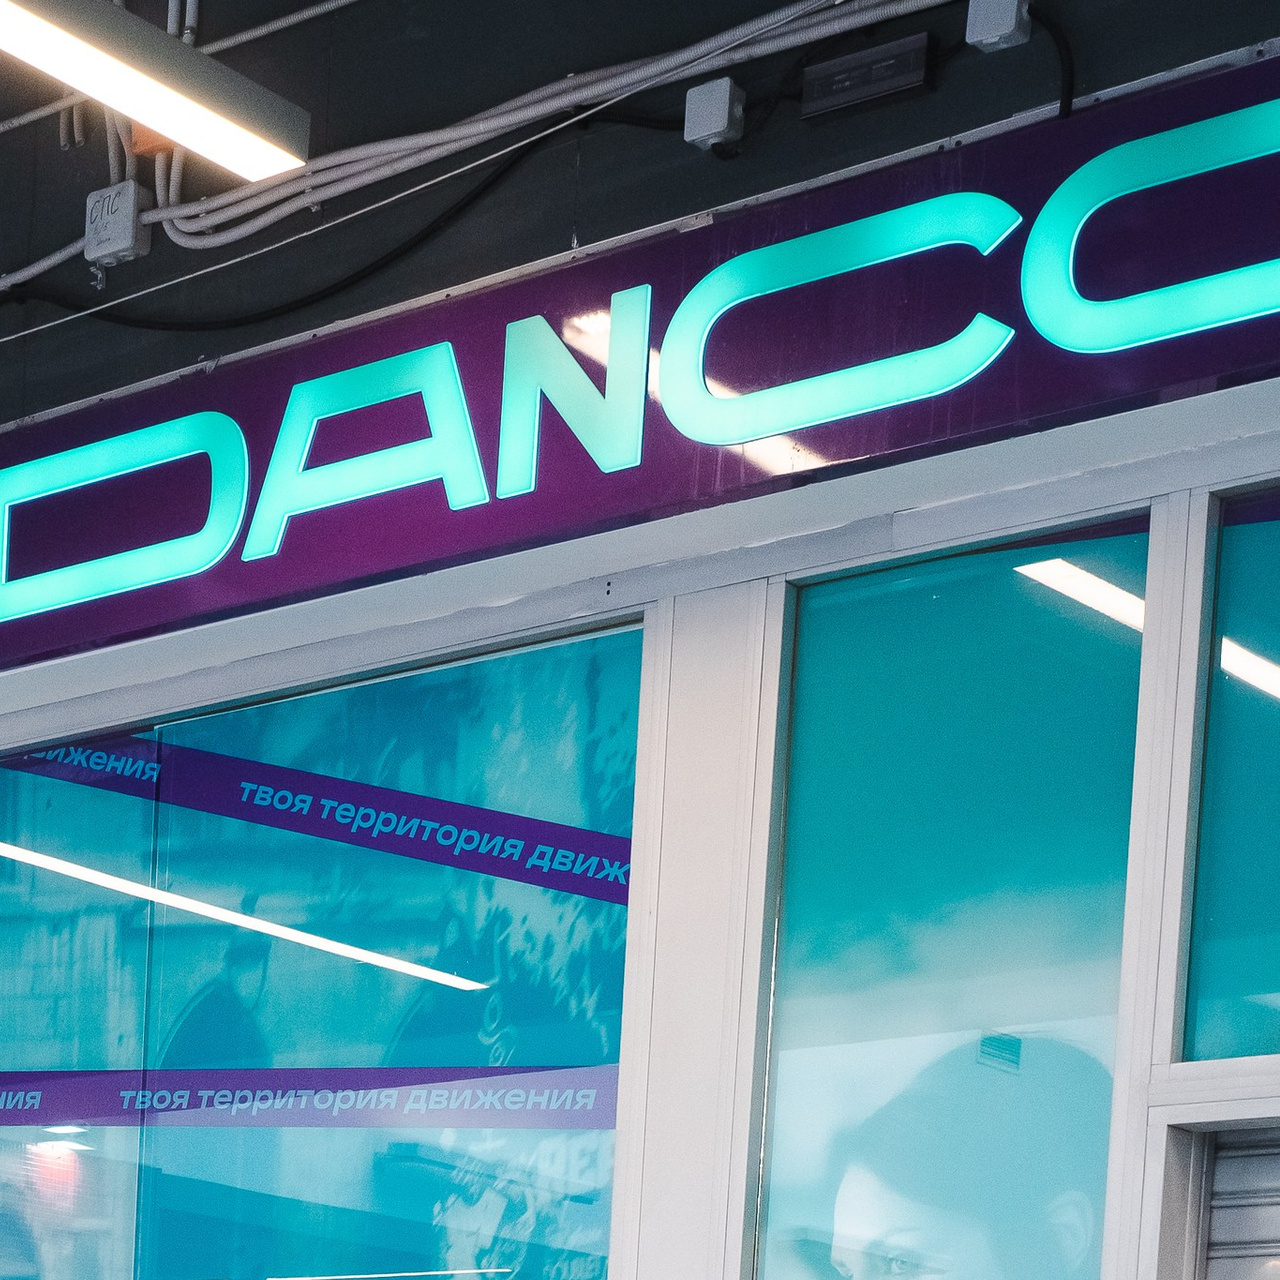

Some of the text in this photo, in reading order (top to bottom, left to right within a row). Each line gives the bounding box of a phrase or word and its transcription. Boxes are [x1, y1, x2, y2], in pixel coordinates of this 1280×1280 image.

[23, 746, 161, 783] ижения
[240, 781, 313, 815] твоя
[320, 798, 524, 861] территория
[119, 1088, 597, 1116] твоя территория движения
